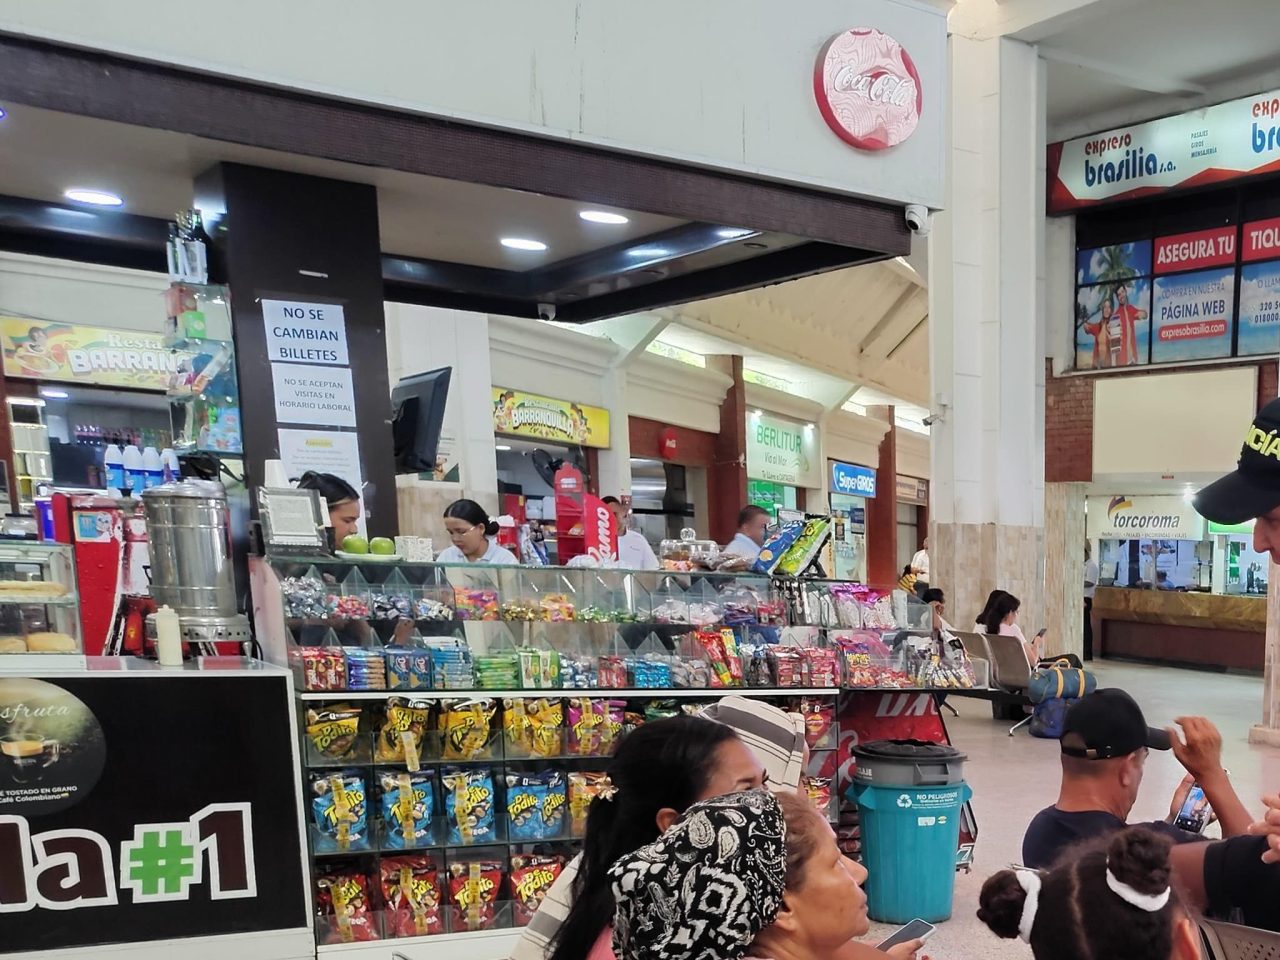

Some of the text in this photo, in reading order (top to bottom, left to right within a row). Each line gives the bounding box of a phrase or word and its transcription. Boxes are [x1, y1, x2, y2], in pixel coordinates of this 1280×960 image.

[1085, 133, 1131, 157] expreso
[1085, 147, 1157, 188] brasilia
[1157, 234, 1234, 264] ASEGURA TU
[1161, 286, 1188, 300] COMPRA
[1188, 284, 1198, 296] EN
[283, 307, 324, 321] NO SE
[1161, 299, 1225, 320] PÁGINA WEB
[273, 326, 339, 342] CAMBIAN
[1161, 323, 1225, 339] expresobrasilia.com
[280, 347, 337, 361] BILLETES
[284, 378, 343, 389] NO SE ACEPTAN
[295, 390, 335, 400] VISITAS EN
[279, 400, 352, 412] HORARIO LABORAL
[511, 409, 574, 437] BARRANQUILLA
[756, 425, 802, 454] BERLITUR
[1113, 512, 1180, 528] torcoroma
[6, 789, 39, 797] TOSTADO
[51, 785, 78, 793] GRANO
[15, 794, 61, 802] Colombiano
[507, 795, 538, 818] Todito
[516, 871, 554, 902] Todito
